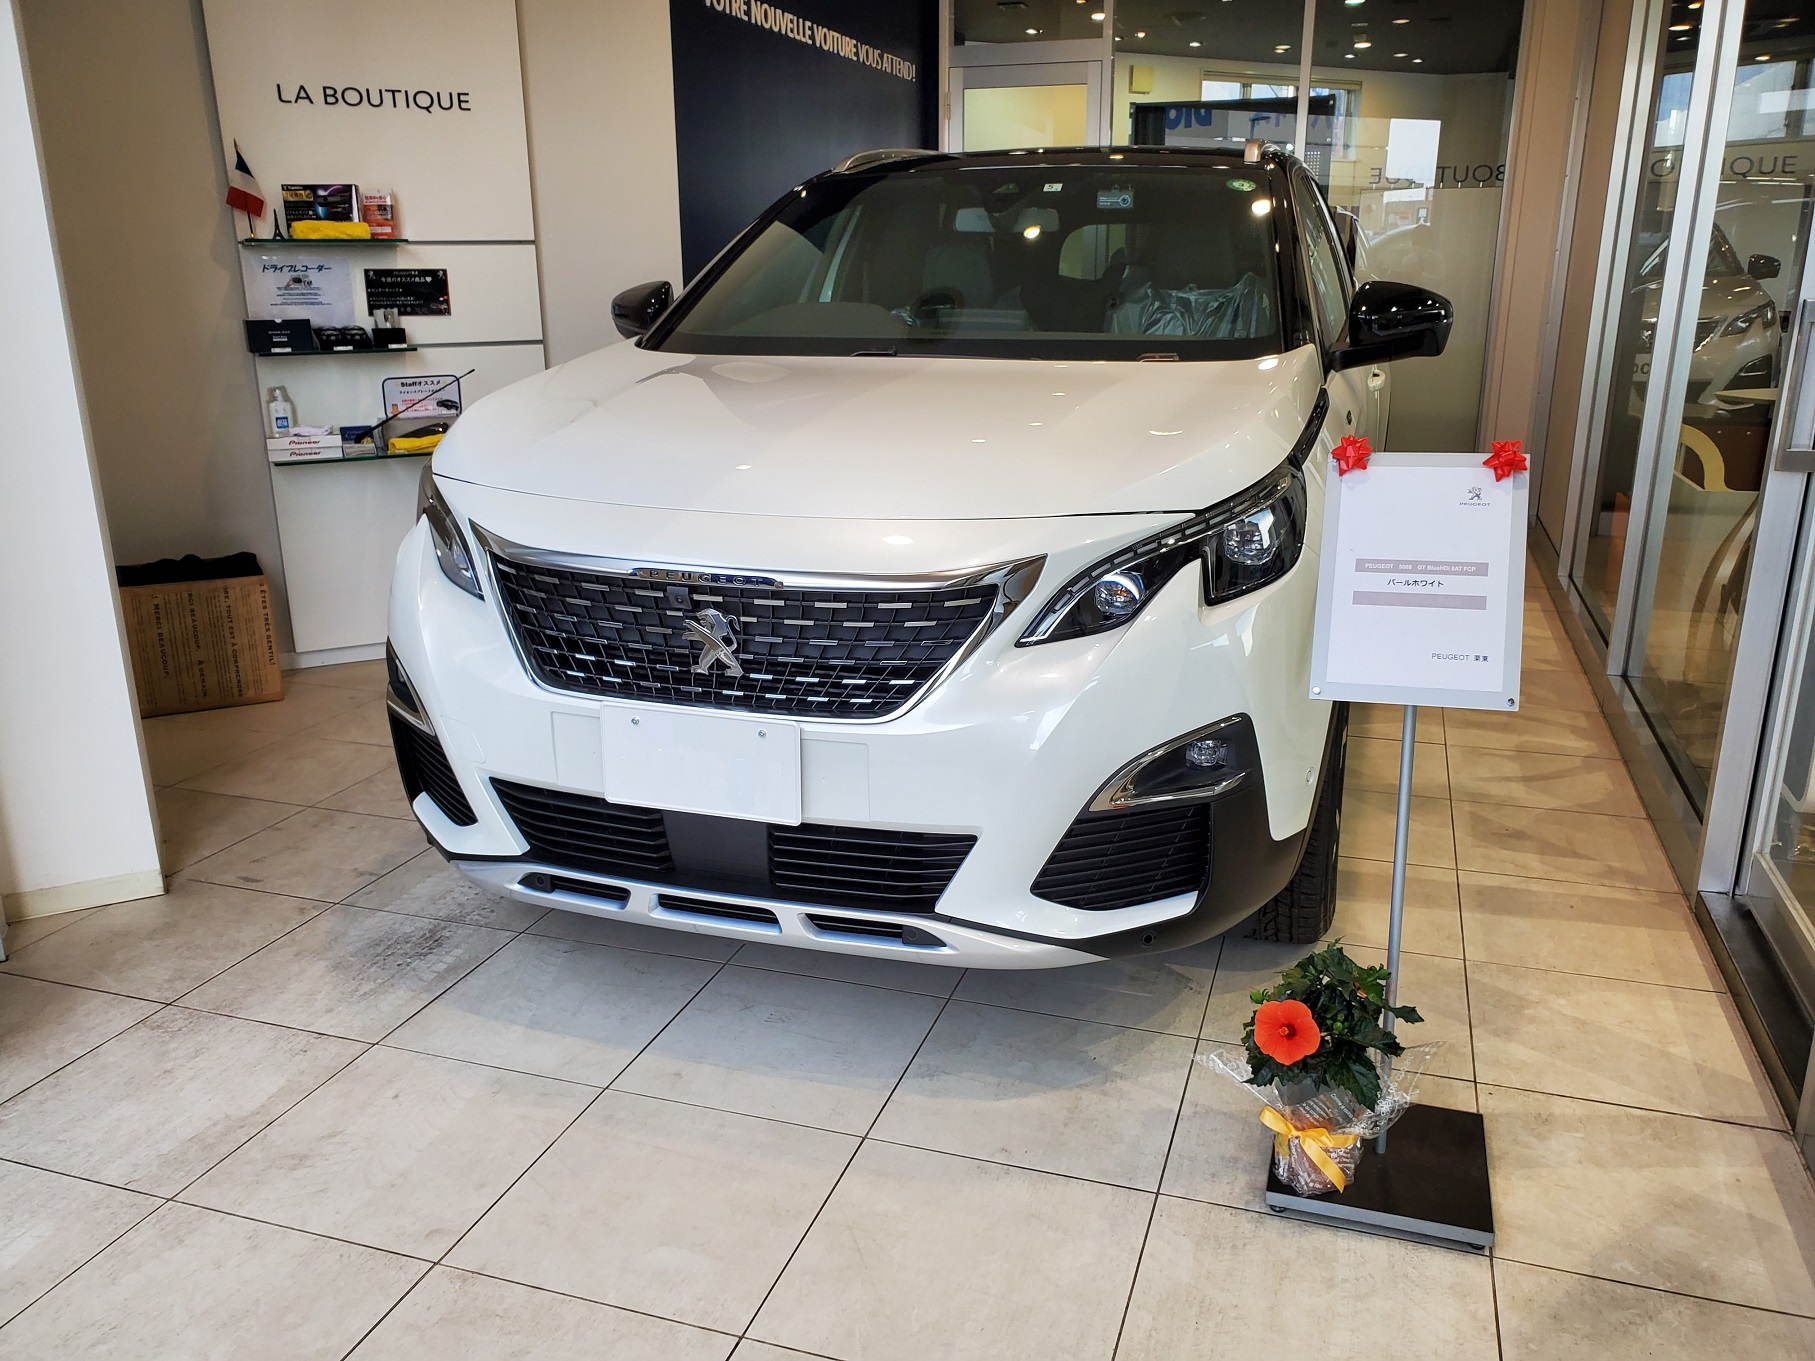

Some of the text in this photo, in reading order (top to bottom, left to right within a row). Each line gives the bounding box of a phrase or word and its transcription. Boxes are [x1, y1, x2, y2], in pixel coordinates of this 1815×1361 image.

[751, 1, 813, 45] NOUVELLE
[813, 24, 858, 61] VOITURE
[858, 42, 882, 70] VOUS
[882, 53, 916, 82] ATTEND!
[276, 83, 472, 114] LA BOUTIQUE
[262, 264, 332, 273] ドライブレコーダー
[649, 570, 764, 587] PEUGEOT
[153, 603, 162, 629] MERCI
[158, 630, 170, 678] BEAUCOUP.
[232, 648, 243, 697] COMPRENDRE
[1432, 653, 1470, 661] PEUGEOT
